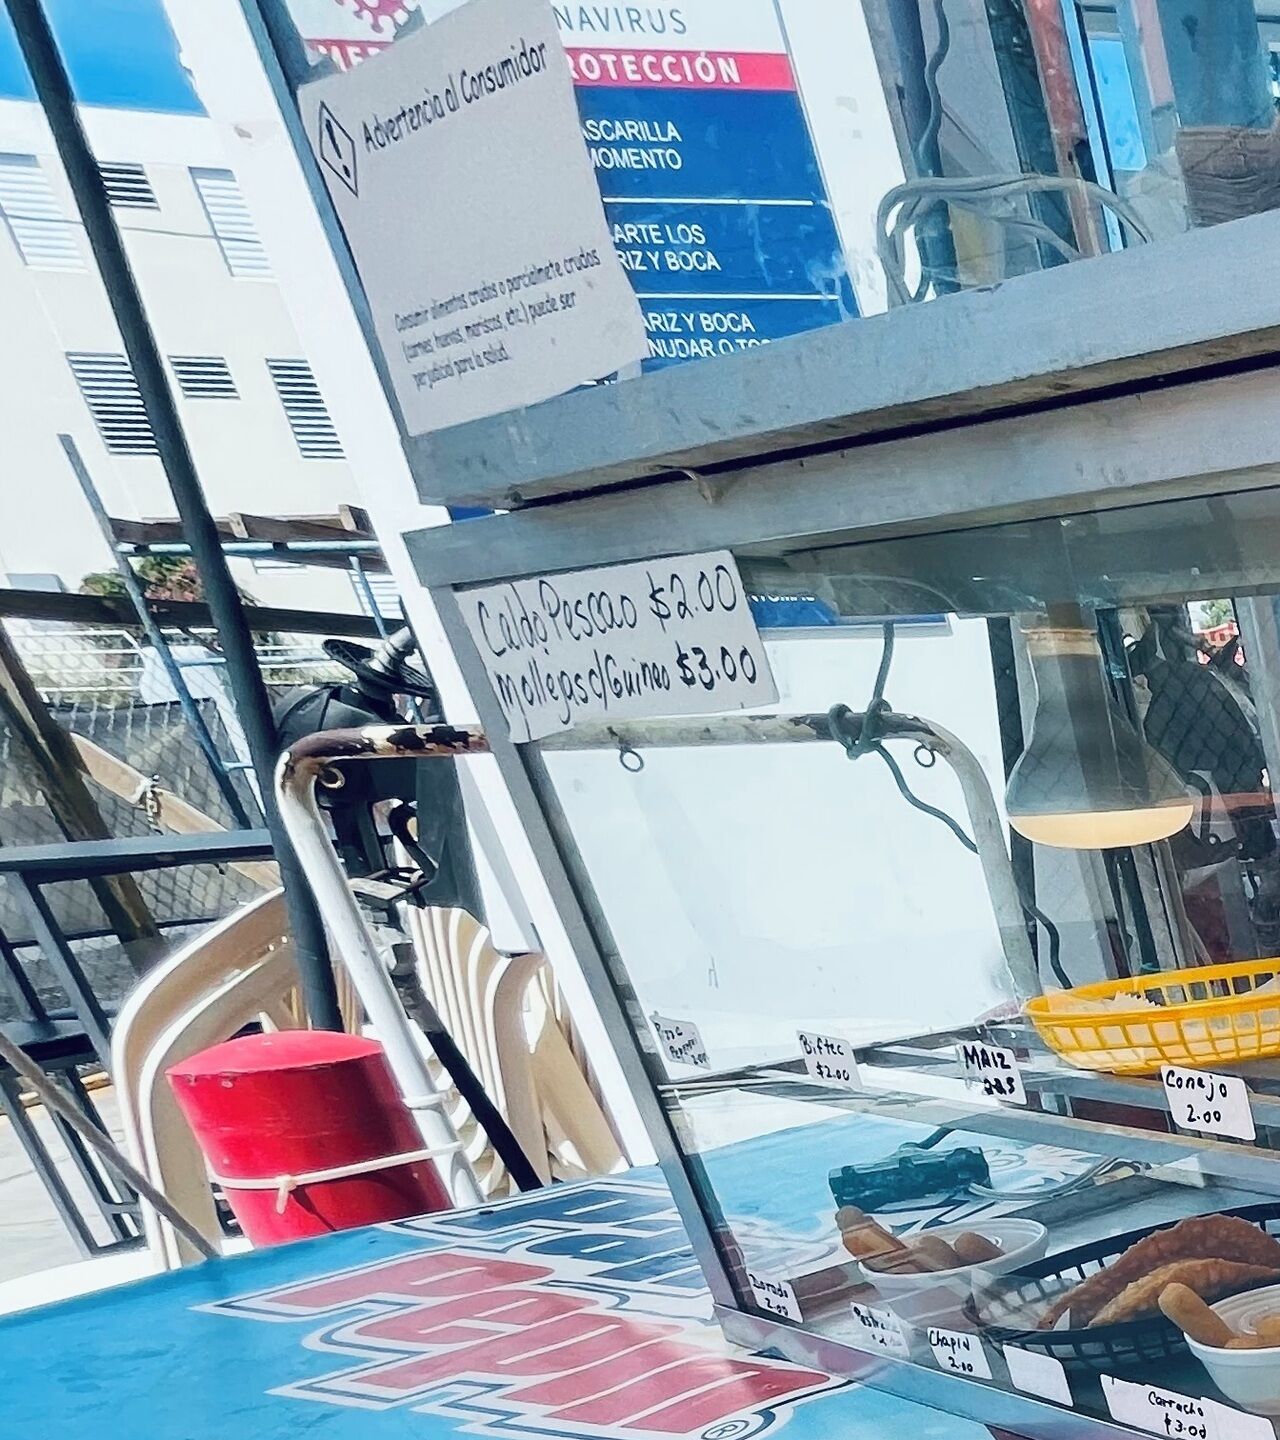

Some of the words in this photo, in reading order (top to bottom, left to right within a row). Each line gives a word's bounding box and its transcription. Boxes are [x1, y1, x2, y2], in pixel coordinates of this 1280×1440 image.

[361, 87, 445, 152] Advertencia
[445, 74, 461, 112] al
[461, 37, 547, 104] Consumidor
[665, 224, 706, 245] LOS
[647, 251, 660, 271] Y
[666, 250, 722, 272] BOCA
[559, 291, 576, 309] ser
[678, 313, 696, 333] Y
[700, 313, 755, 334] BOCA
[478, 583, 548, 656] Caldo
[647, 565, 737, 632] $2.00
[676, 641, 757, 692] $3.00
[799, 1034, 845, 1057] Biftec
[817, 1063, 850, 1081] $2.00
[1166, 1070, 1227, 1102] Conejo
[1187, 1104, 1222, 1124] 2.00
[765, 1298, 789, 1317] 2.00
[948, 1356, 973, 1373] 2.00
[1164, 1412, 1207, 1440] $3.00
